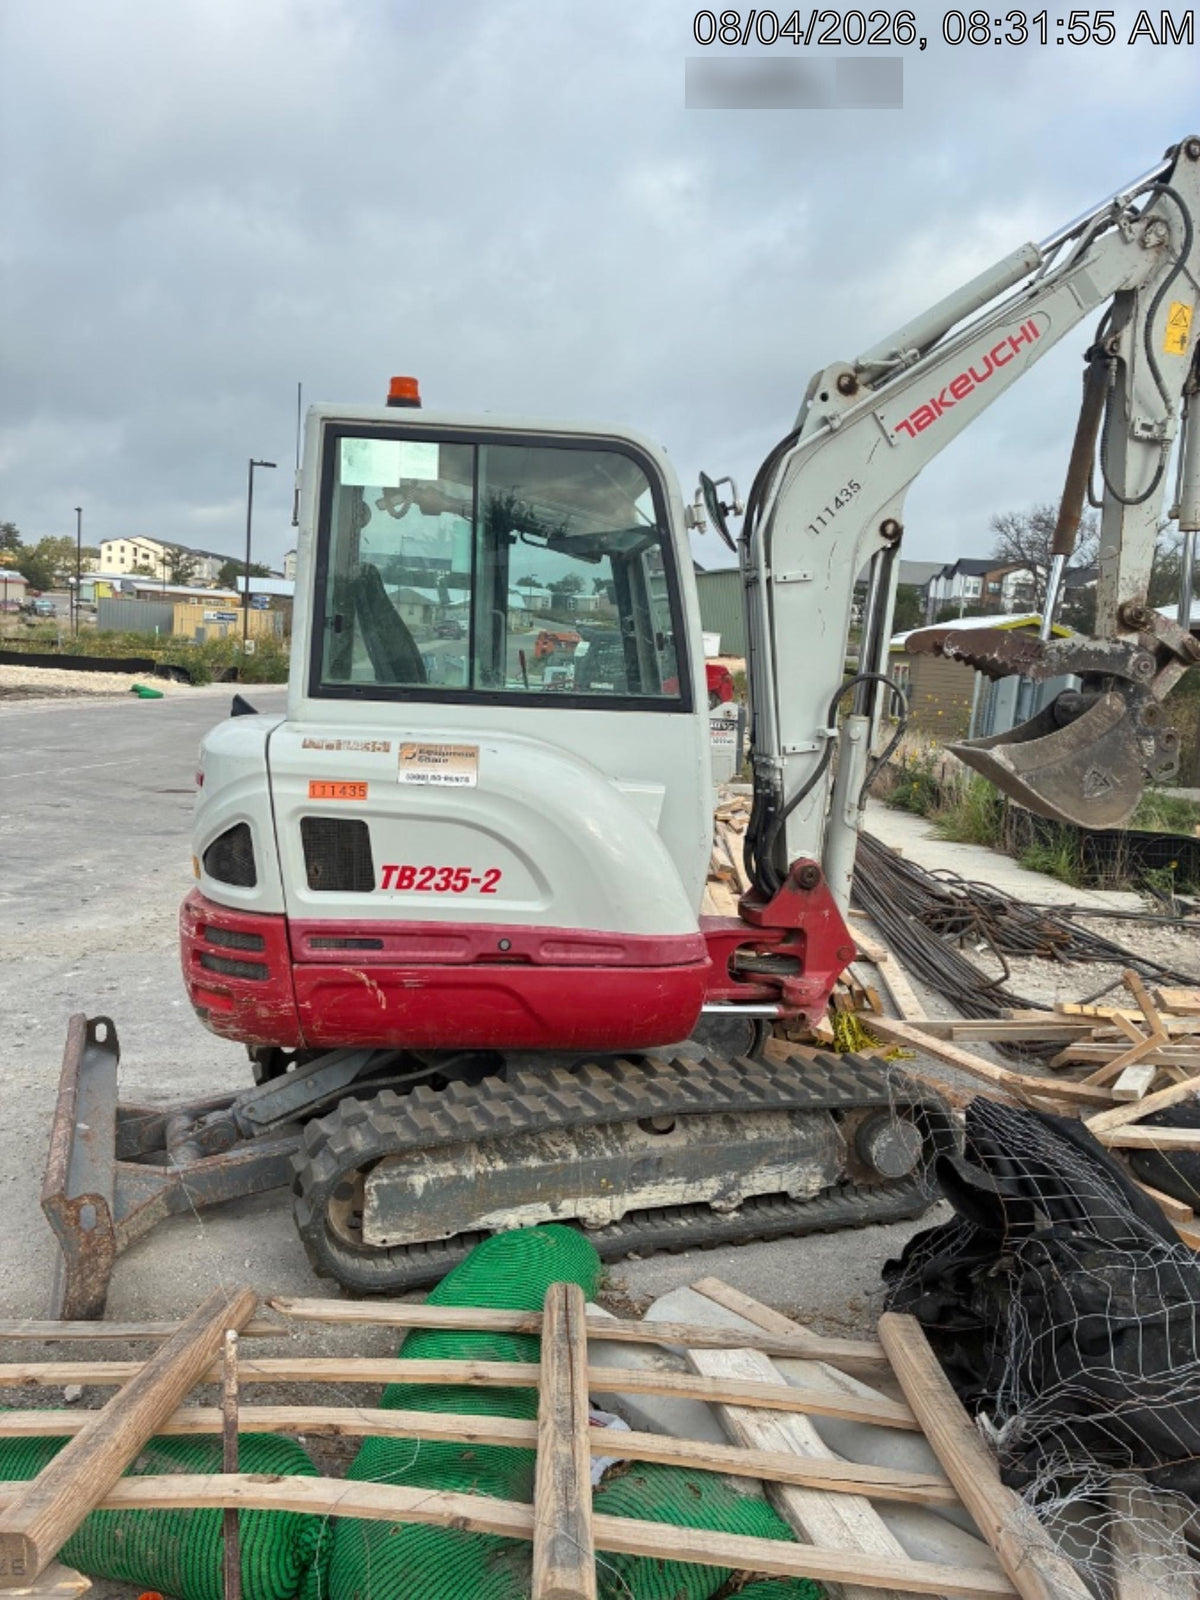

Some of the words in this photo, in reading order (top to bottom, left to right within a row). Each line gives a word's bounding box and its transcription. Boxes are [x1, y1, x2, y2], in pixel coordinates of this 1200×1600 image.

[894, 319, 1041, 438] TAKEUCHI
[808, 478, 862, 535] 111435
[310, 783, 367, 798] 111435
[380, 864, 503, 894] TB235-2
